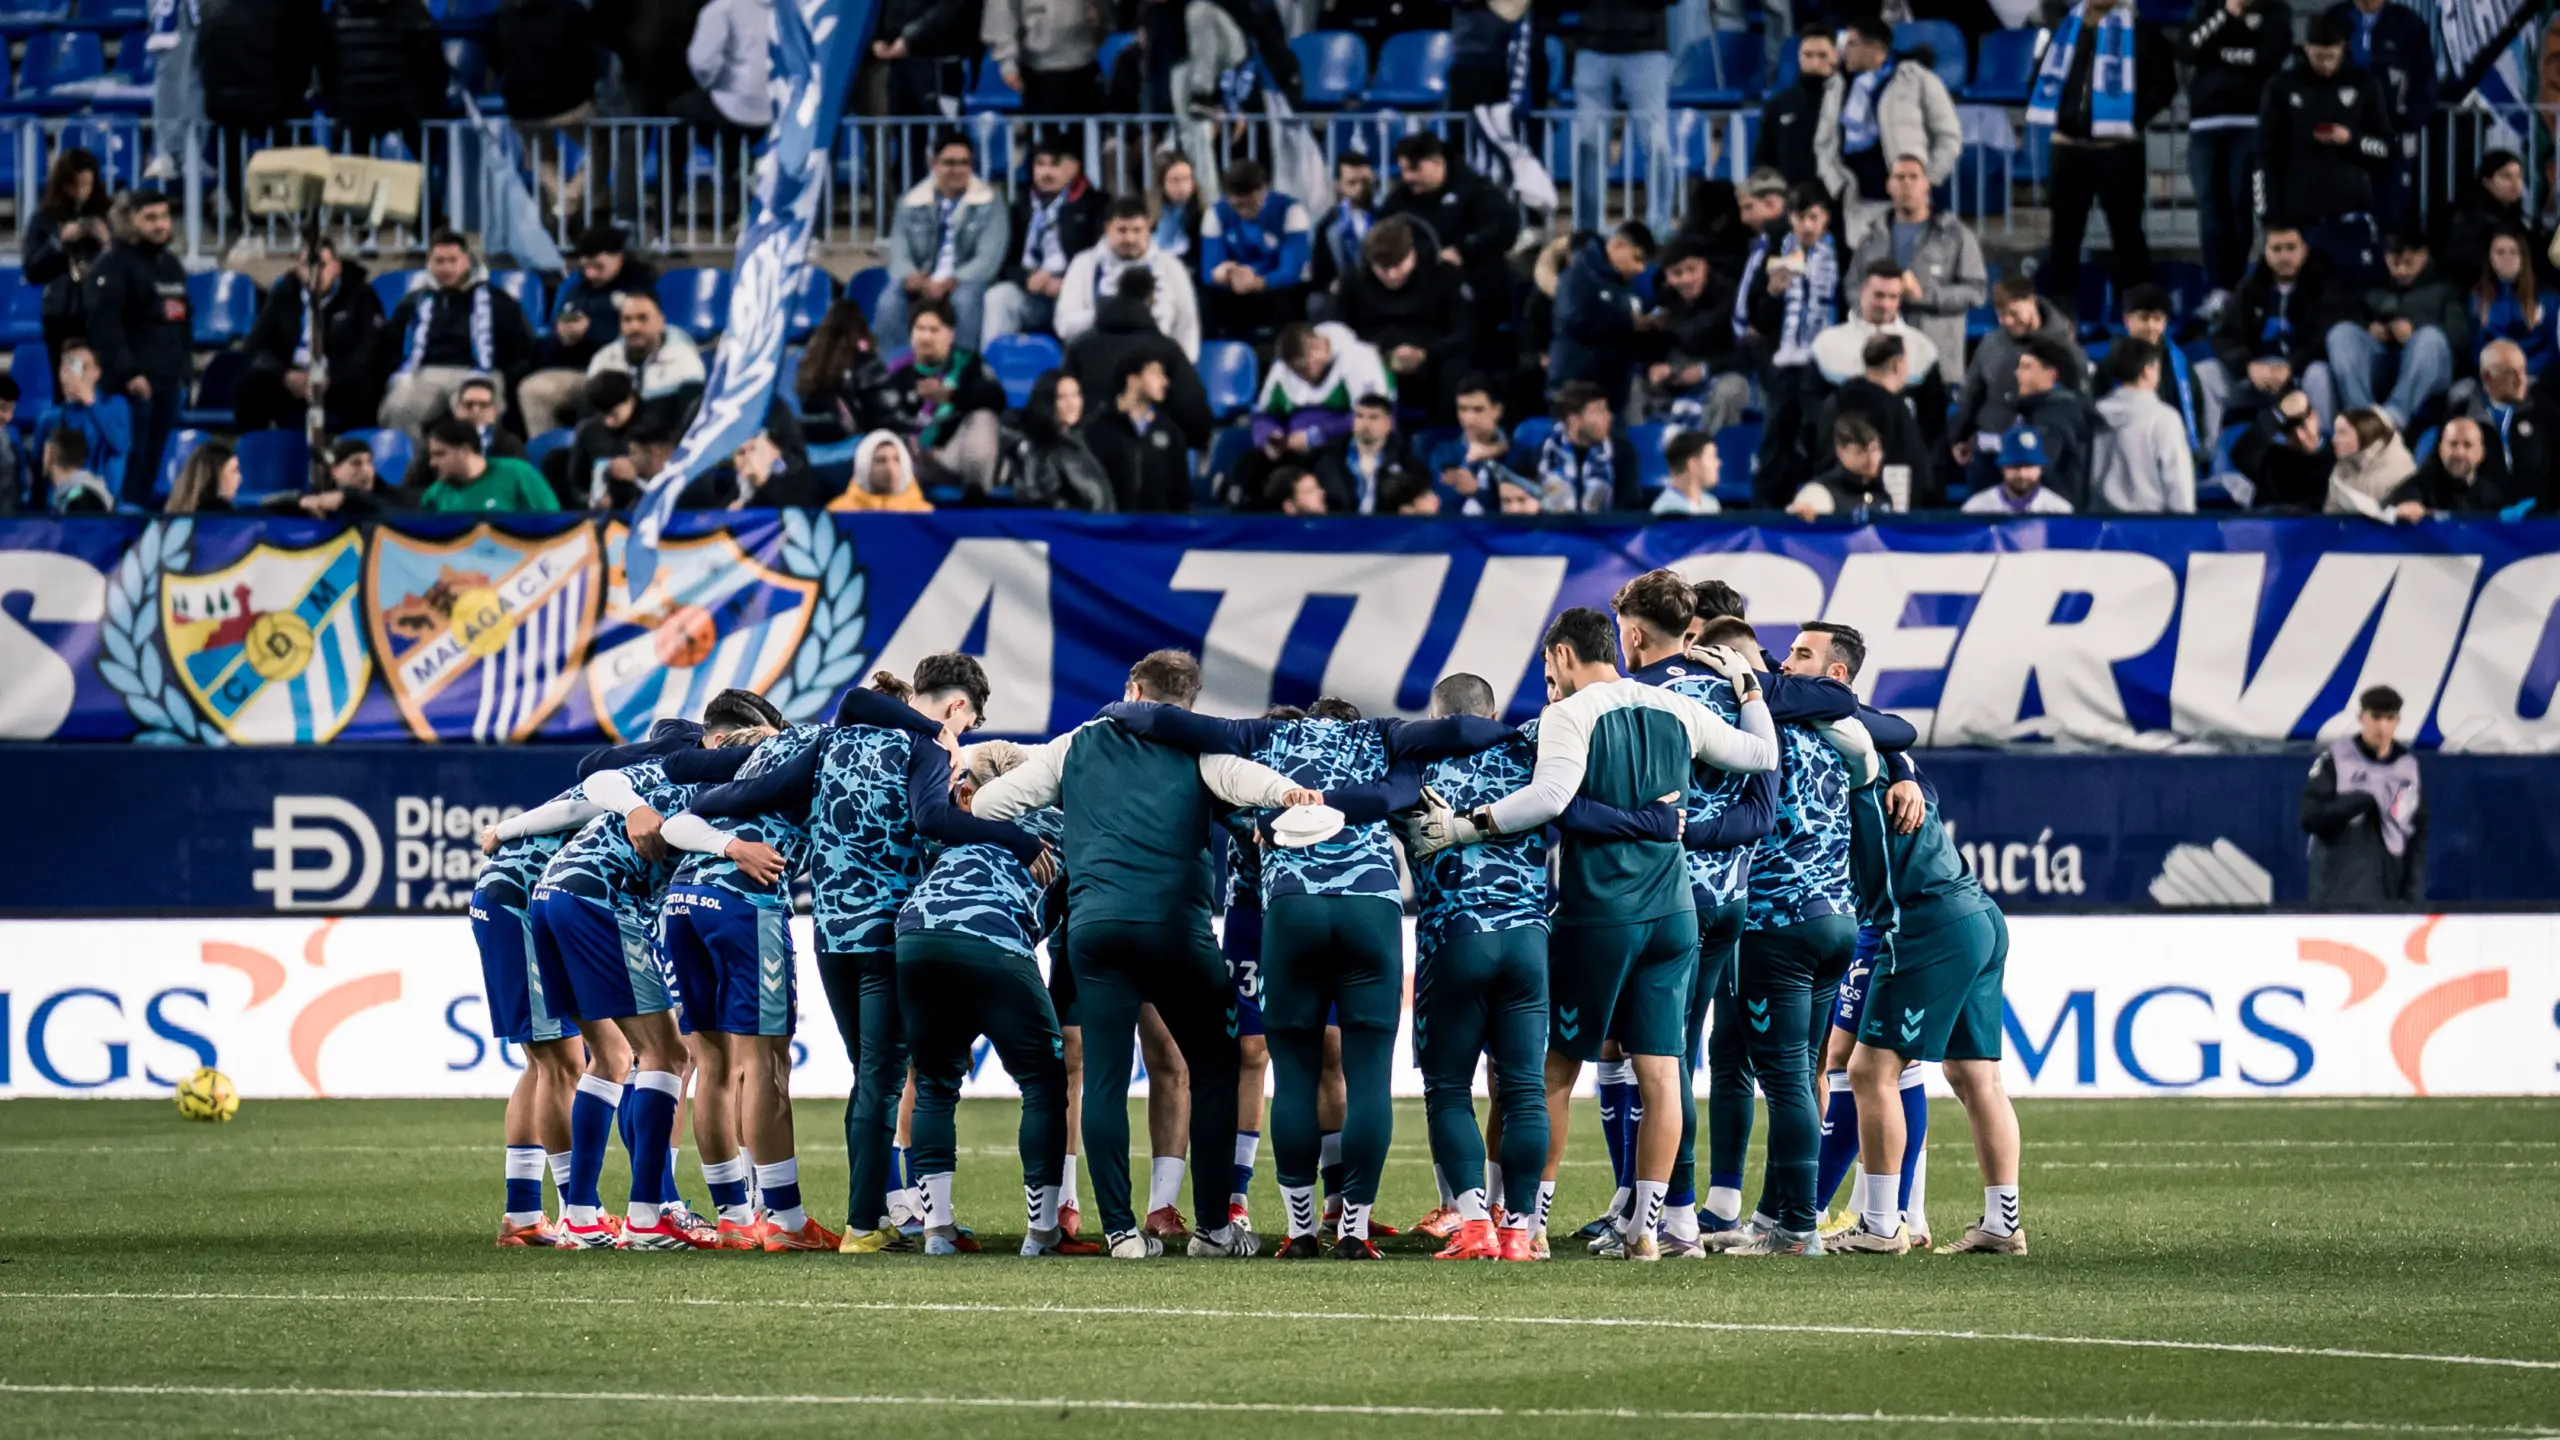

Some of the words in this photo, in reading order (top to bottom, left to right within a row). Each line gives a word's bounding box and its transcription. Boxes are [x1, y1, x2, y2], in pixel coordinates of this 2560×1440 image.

[856, 536, 1055, 735] A
[699, 895, 722, 910] SOL
[1945, 820, 2086, 896] ucía
[0, 987, 218, 1089] GS
[2001, 985, 2315, 1088] MGS
